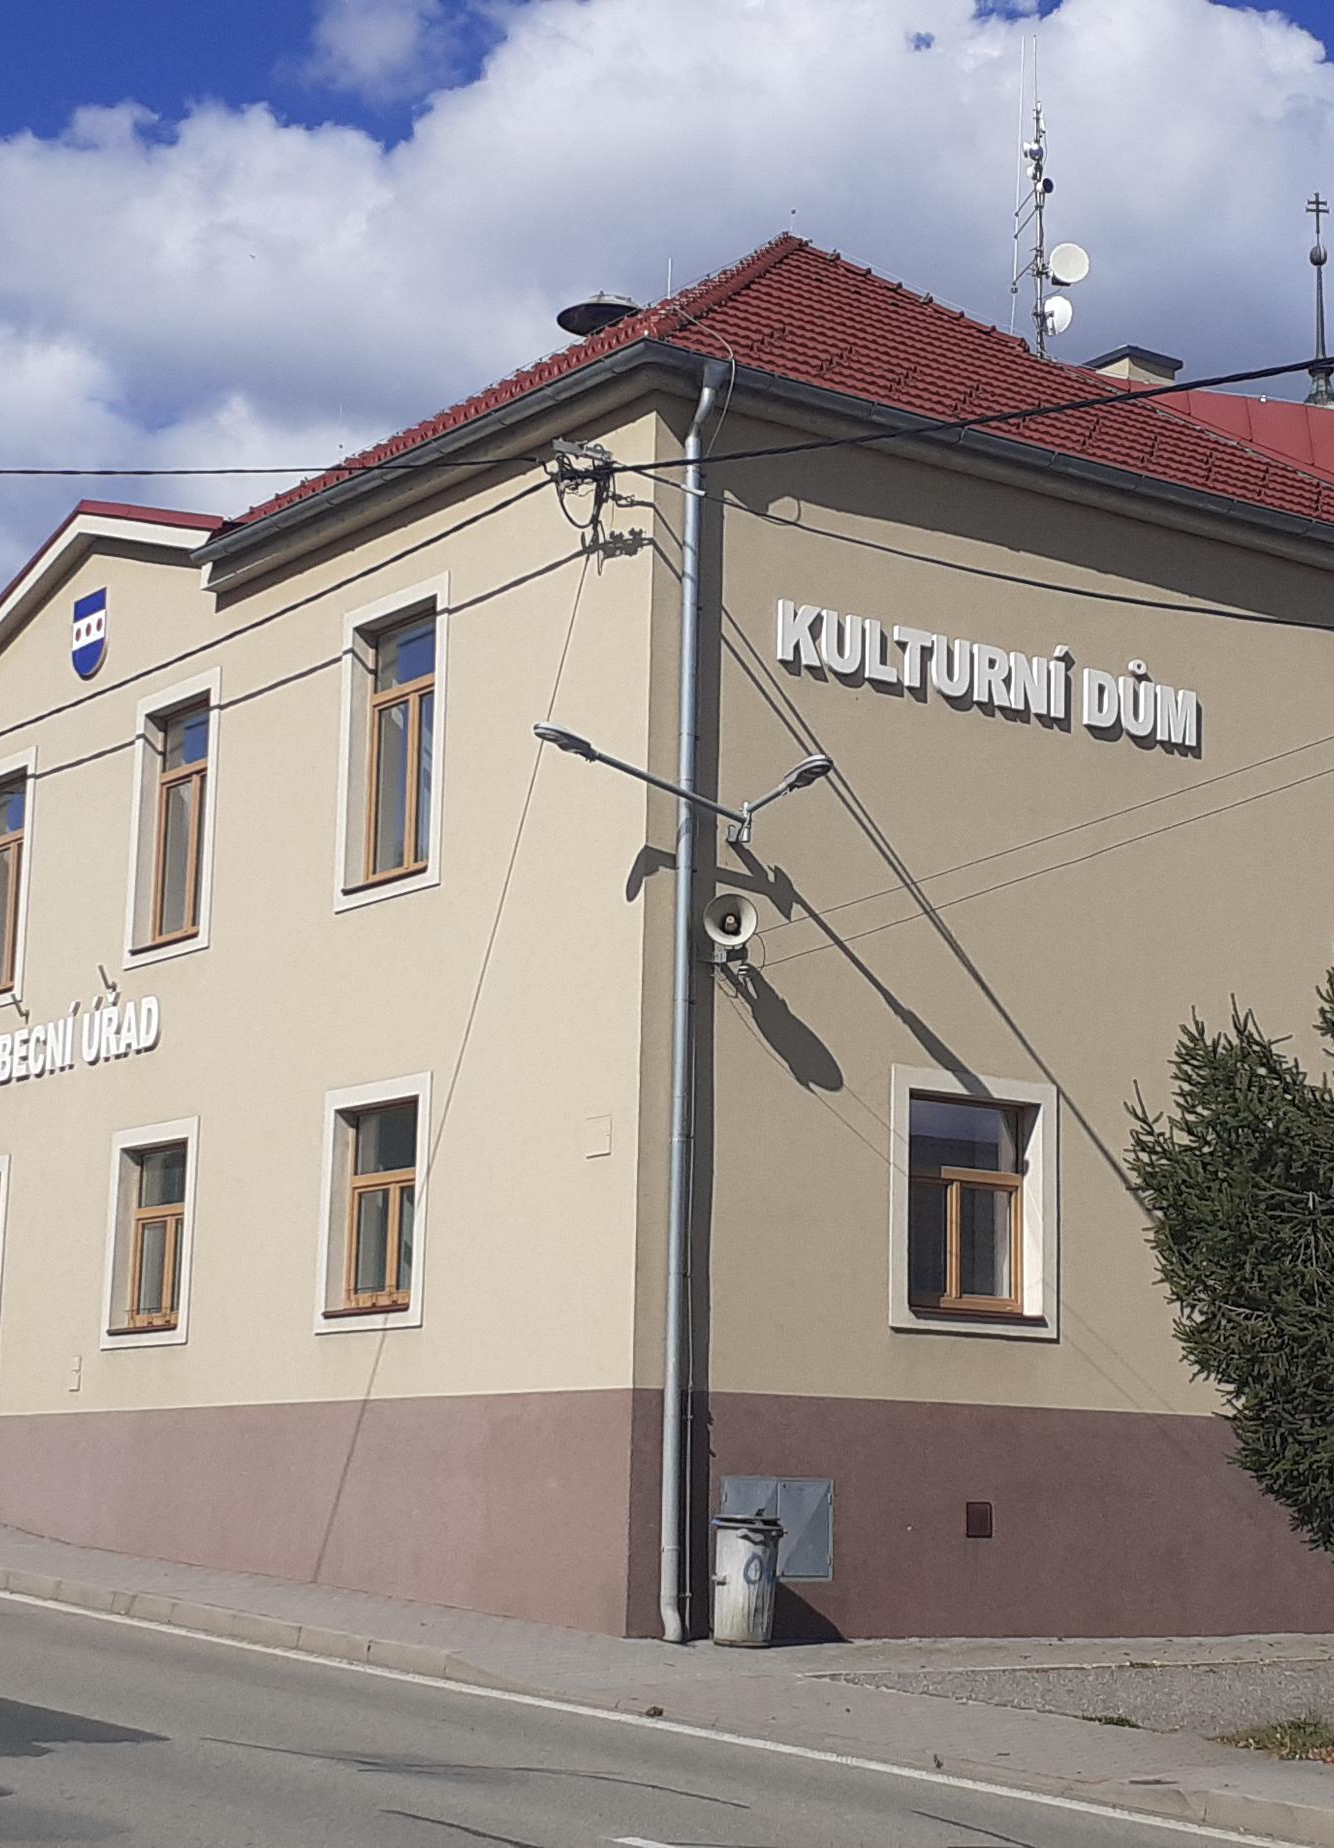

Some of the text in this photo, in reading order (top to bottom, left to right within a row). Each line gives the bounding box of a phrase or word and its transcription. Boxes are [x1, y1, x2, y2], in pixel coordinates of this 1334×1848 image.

[776, 598, 1197, 747] KULTURNÍ DŮM
[82, 992, 159, 1062] ÚŘAD
